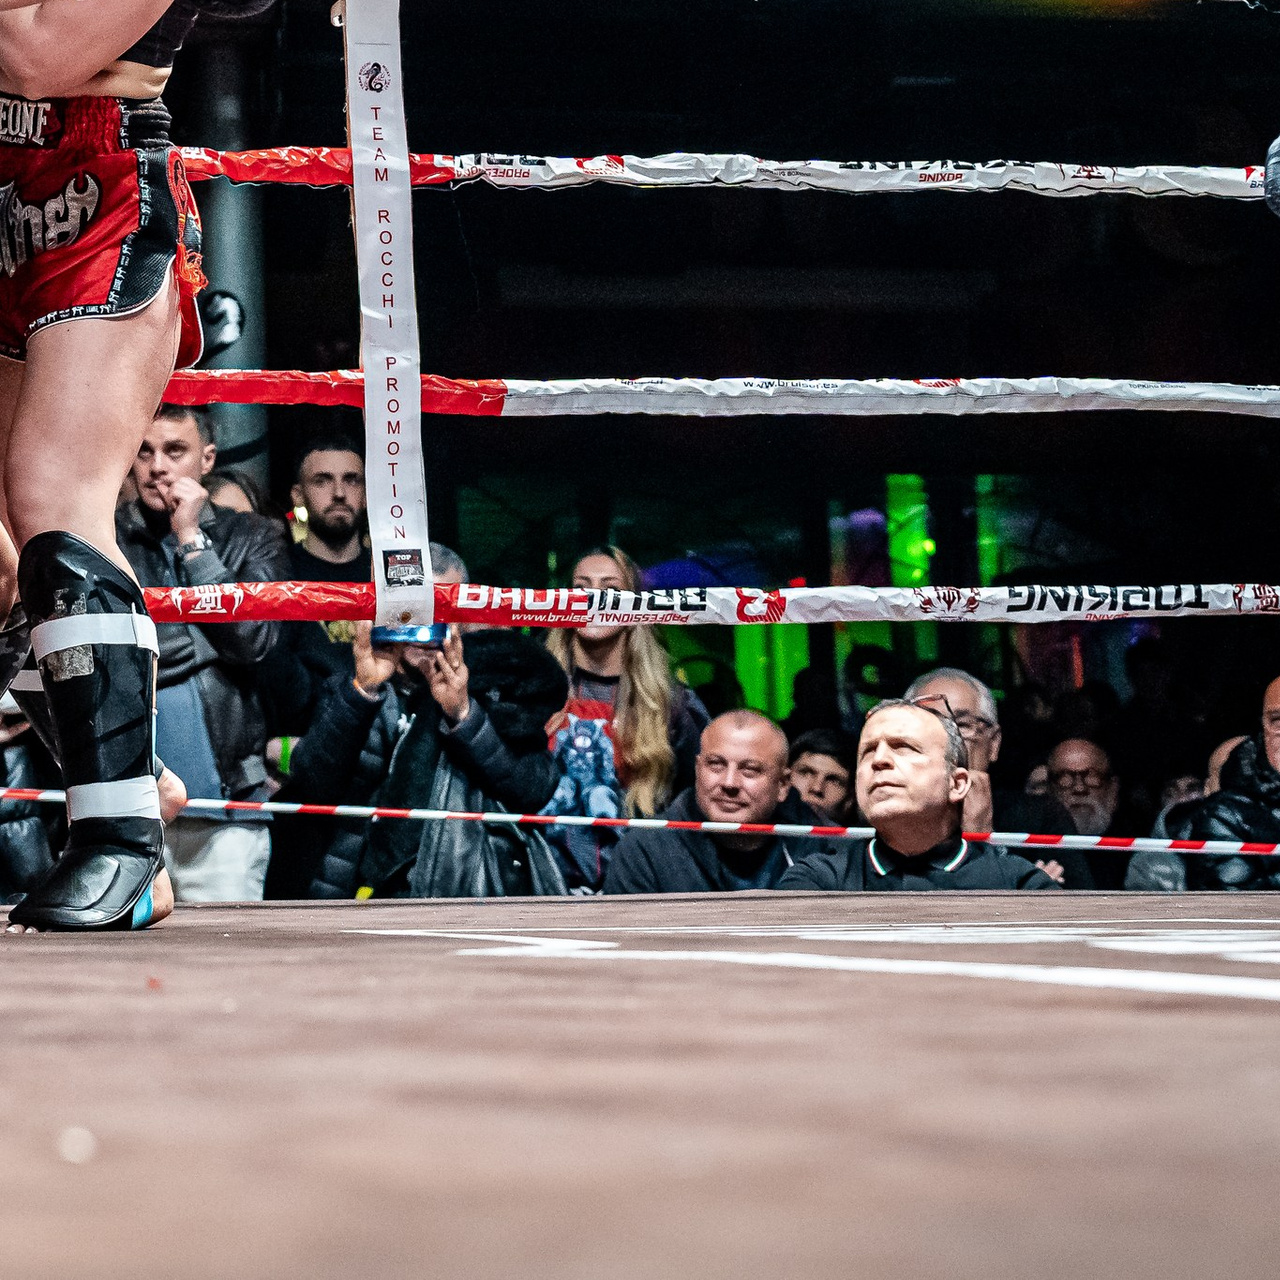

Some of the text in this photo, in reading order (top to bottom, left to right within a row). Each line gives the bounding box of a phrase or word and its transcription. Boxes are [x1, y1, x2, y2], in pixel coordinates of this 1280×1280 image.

[370, 106, 389, 182] TEAM
[919, 172, 963, 183] BOXING
[378, 208, 394, 329] ROCCHI
[385, 356, 406, 539] PROMOTION
[598, 612, 691, 624] PROFESSIONAL
